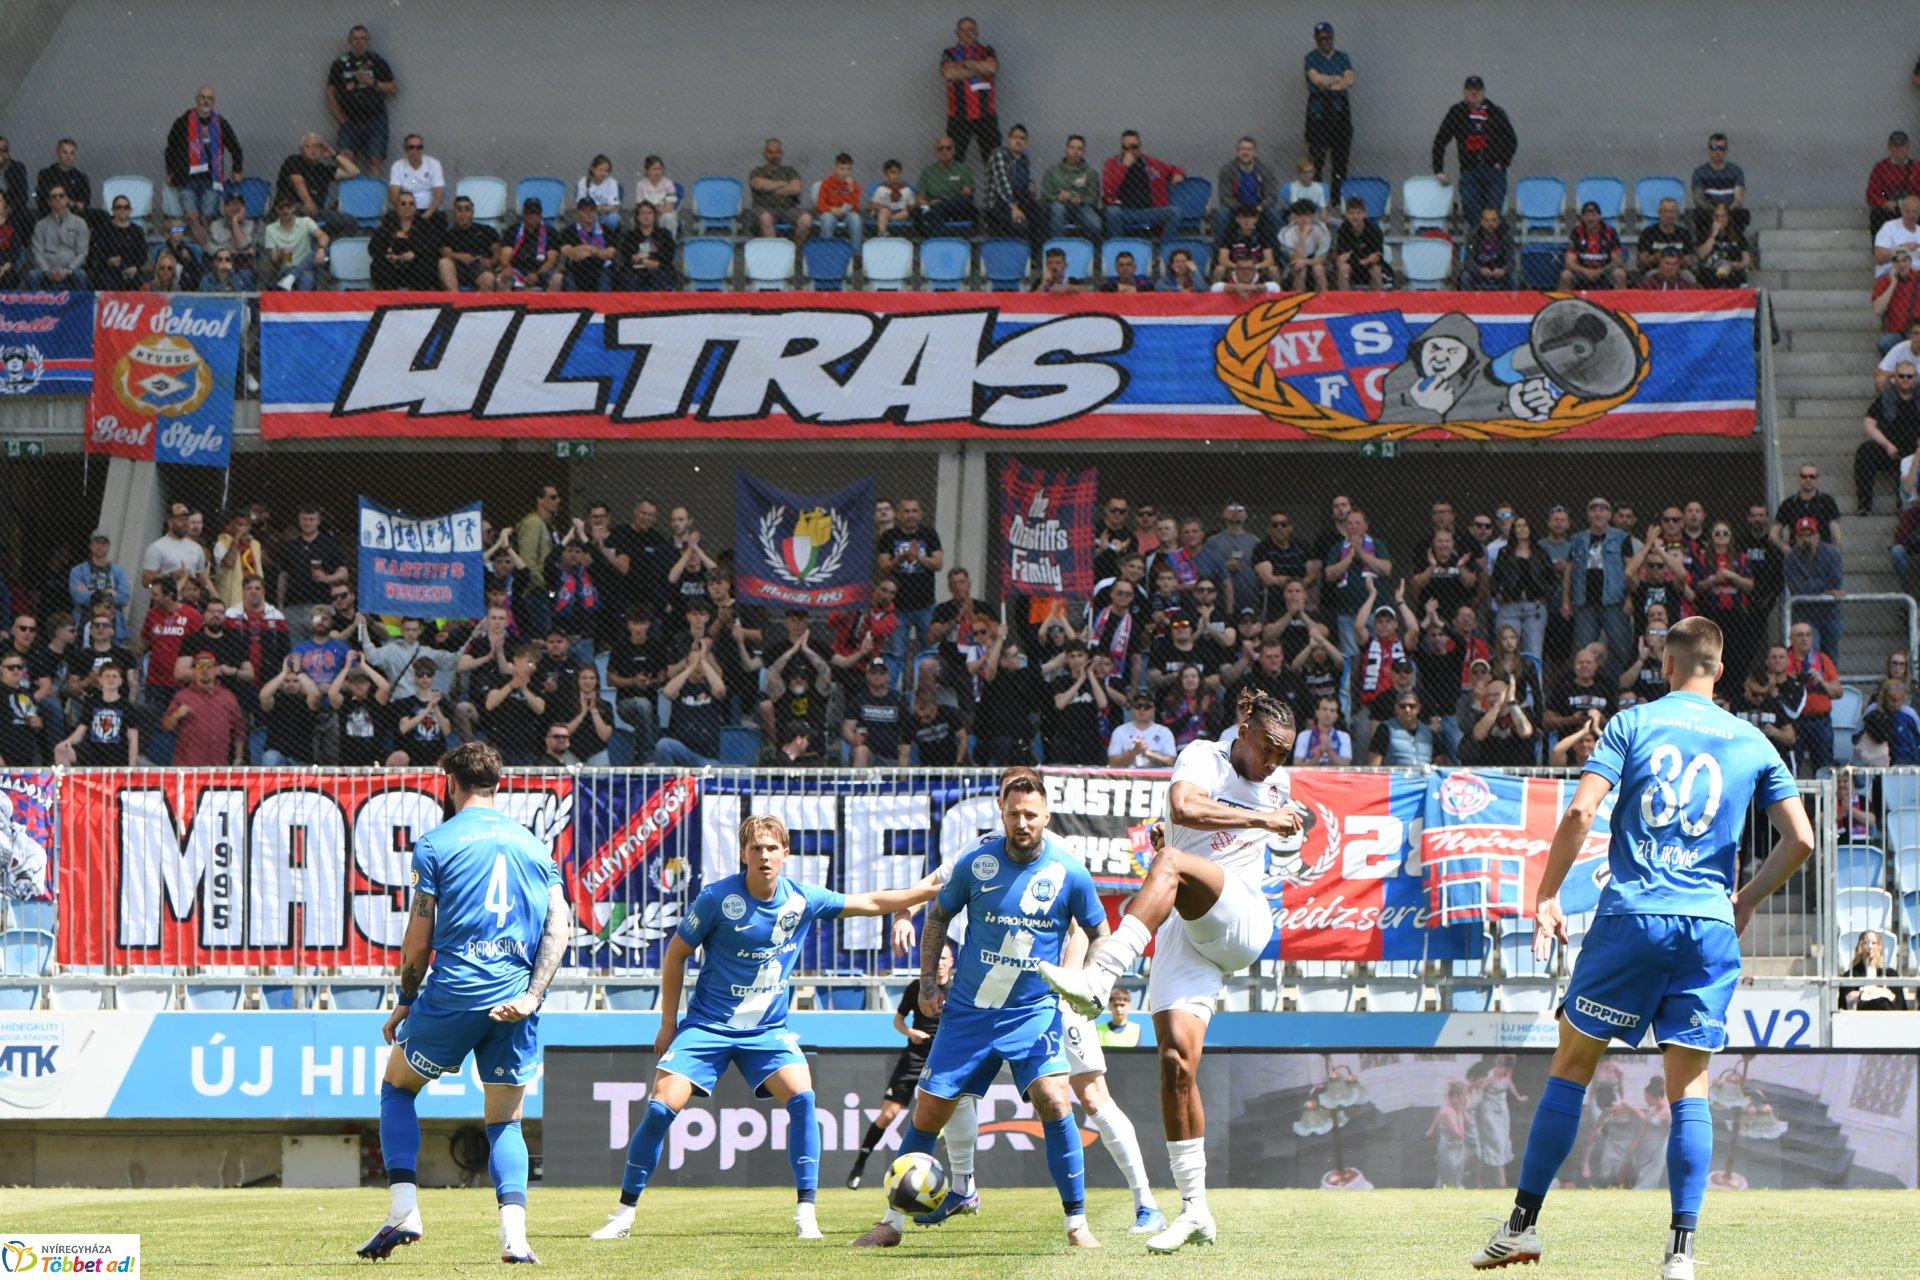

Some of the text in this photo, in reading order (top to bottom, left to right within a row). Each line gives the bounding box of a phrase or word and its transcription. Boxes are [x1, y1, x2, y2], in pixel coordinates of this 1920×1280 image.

[101, 300, 236, 338] Old School
[331, 304, 1134, 428] ULTRAS
[1271, 320, 1393, 369] NY S
[1315, 368, 1391, 407] F C
[91, 415, 223, 457] Best Style
[1012, 548, 1063, 592] Family
[1693, 722, 1734, 740] HOTELS
[1043, 775, 1170, 818] EASTER
[1641, 744, 1722, 837] 80
[117, 786, 547, 951] MAS
[212, 812, 233, 930] 1995
[485, 852, 516, 928] 4
[998, 915, 1053, 928] PROHUMAN
[1068, 1026, 1081, 1045] 9
[191, 1031, 273, 1097] ÚJ
[592, 1082, 908, 1171] Tppmix
